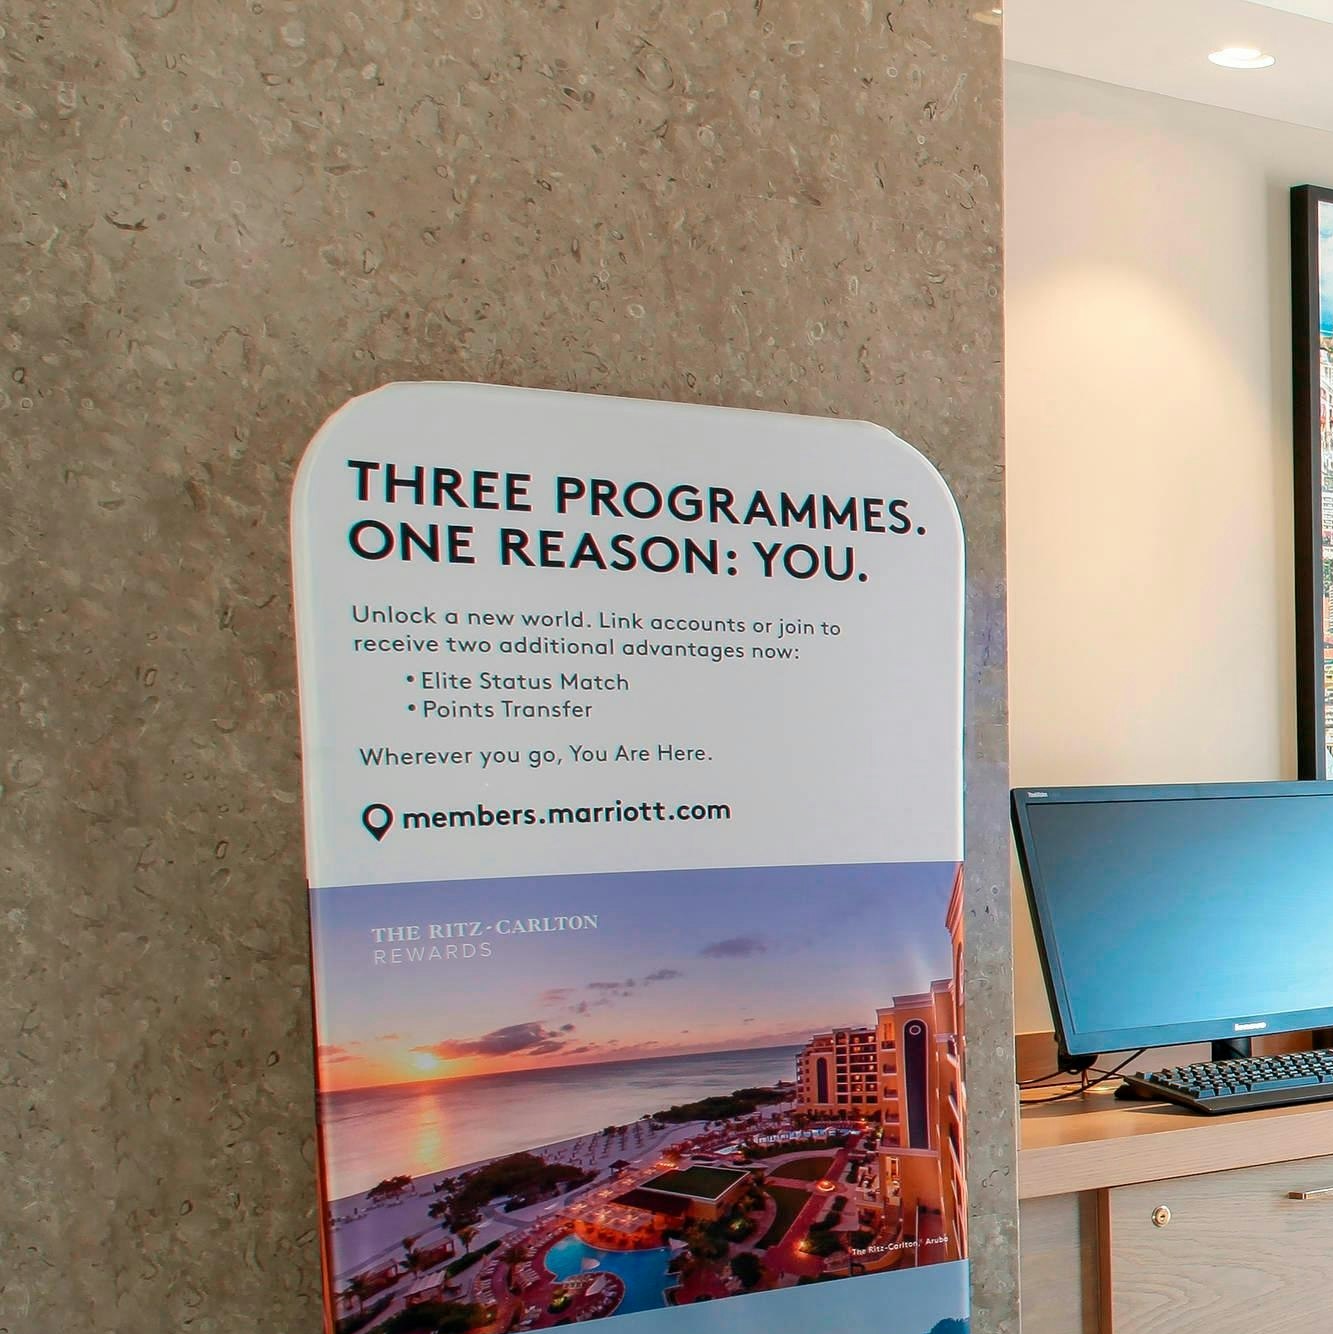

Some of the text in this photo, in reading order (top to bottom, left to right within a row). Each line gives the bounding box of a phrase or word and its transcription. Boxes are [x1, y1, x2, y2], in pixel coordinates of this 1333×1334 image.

[347, 459, 926, 535] THREE PROGRAMMES.
[350, 519, 867, 582] ONE REASON: YOU.
[352, 605, 841, 639] Unlock a new world. Link accounts or join to
[353, 634, 800, 662] receive two additional advantages now:
[421, 671, 630, 691] Elite Status Match
[423, 700, 593, 718] Points Transfer
[360, 745, 713, 768] Wherever you go, You Are Here.
[403, 800, 731, 829] members.marriott.com
[371, 915, 599, 943] THE RITZ-CARLTON
[374, 942, 493, 965] REWARDS
[852, 1248, 866, 1256] The
[925, 1235, 949, 1245] Aruba
